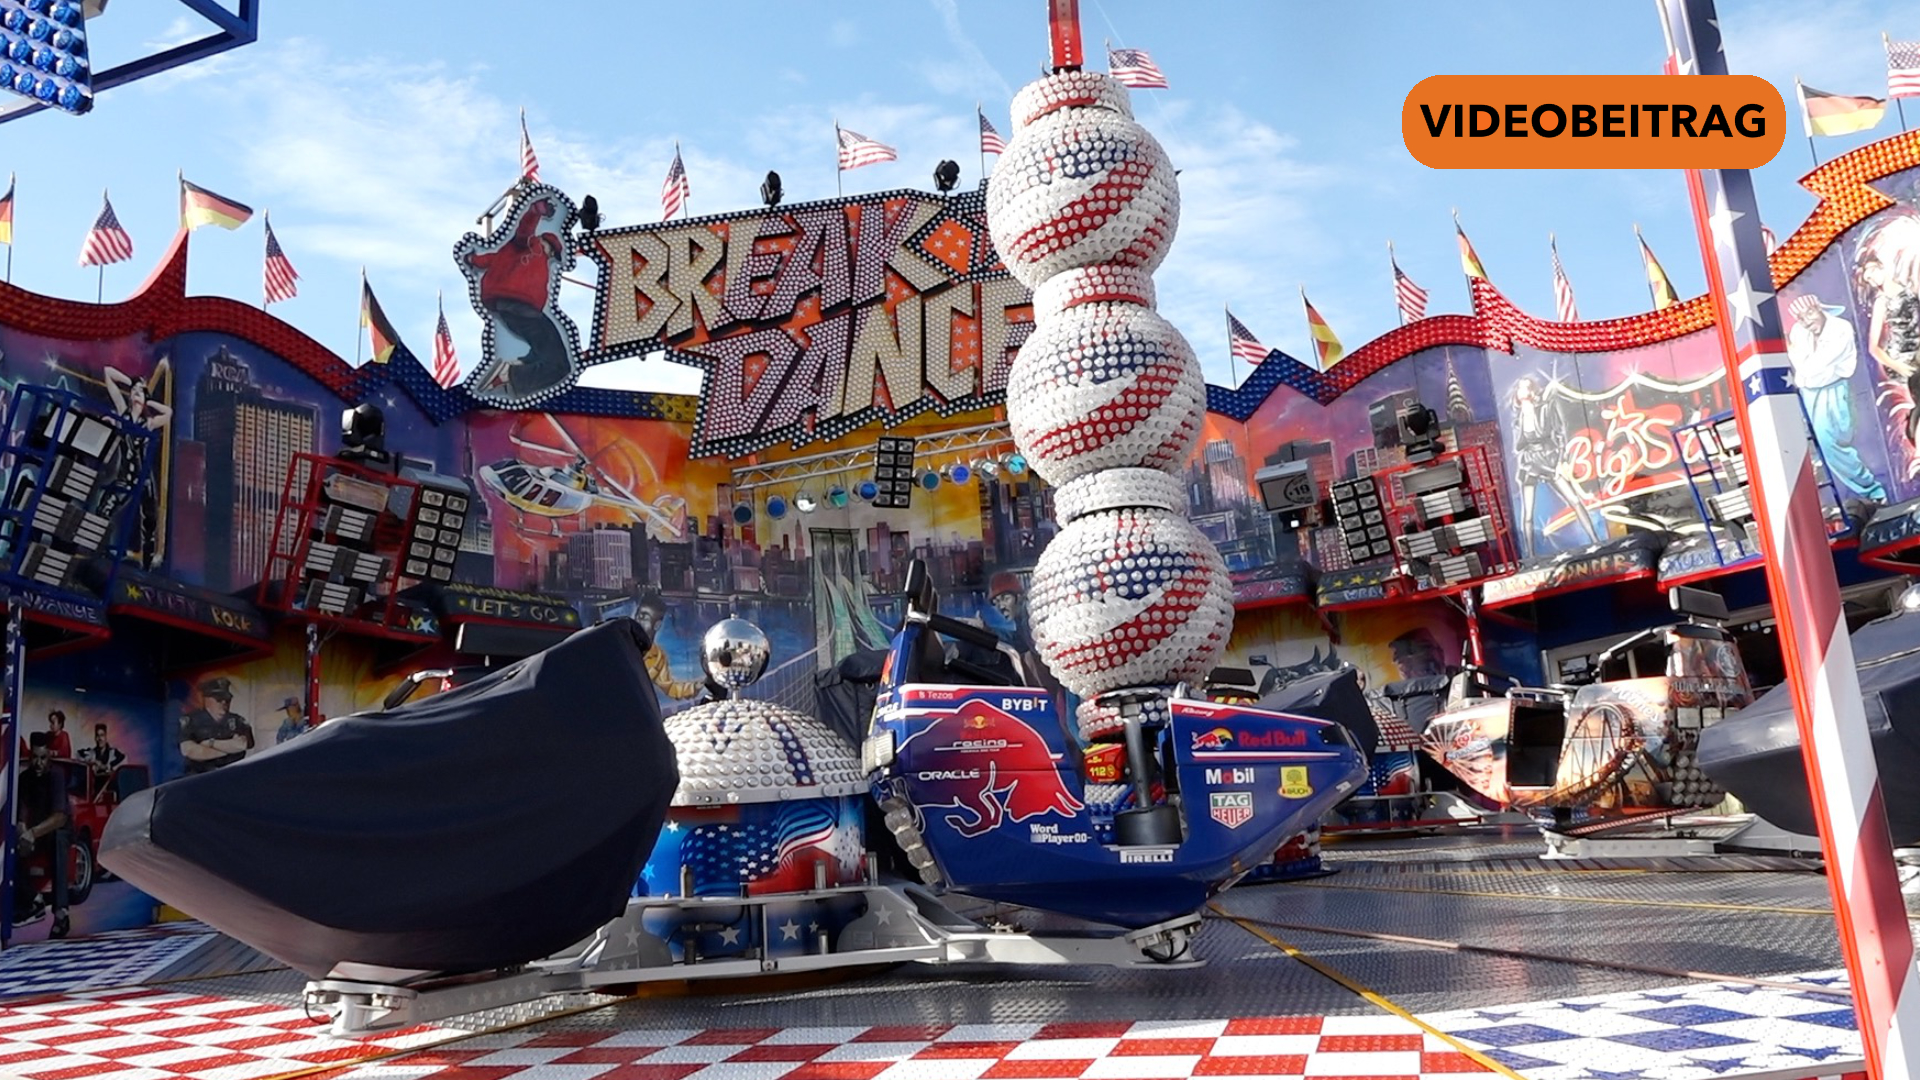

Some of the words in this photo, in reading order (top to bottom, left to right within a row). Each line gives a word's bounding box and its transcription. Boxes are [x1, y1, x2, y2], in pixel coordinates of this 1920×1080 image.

[602, 199, 952, 347] BREAK
[695, 278, 1037, 442] DANCE
[1566, 435, 1642, 498] Big
[472, 598, 520, 618] LET'S
[530, 606, 559, 622] GO
[928, 691, 954, 699] Tezos
[1001, 697, 1048, 712] BYBIT
[952, 739, 1008, 749] racing
[1238, 730, 1272, 747] Red
[1275, 729, 1307, 747] Bull
[918, 768, 980, 780] ORACLE
[1089, 766, 1106, 777] 112
[1205, 767, 1255, 785] Mobil
[1213, 795, 1249, 806] TAG
[1213, 807, 1251, 826] HEUER
[1030, 823, 1059, 834] Word
[1120, 849, 1174, 864] PIRELLI
